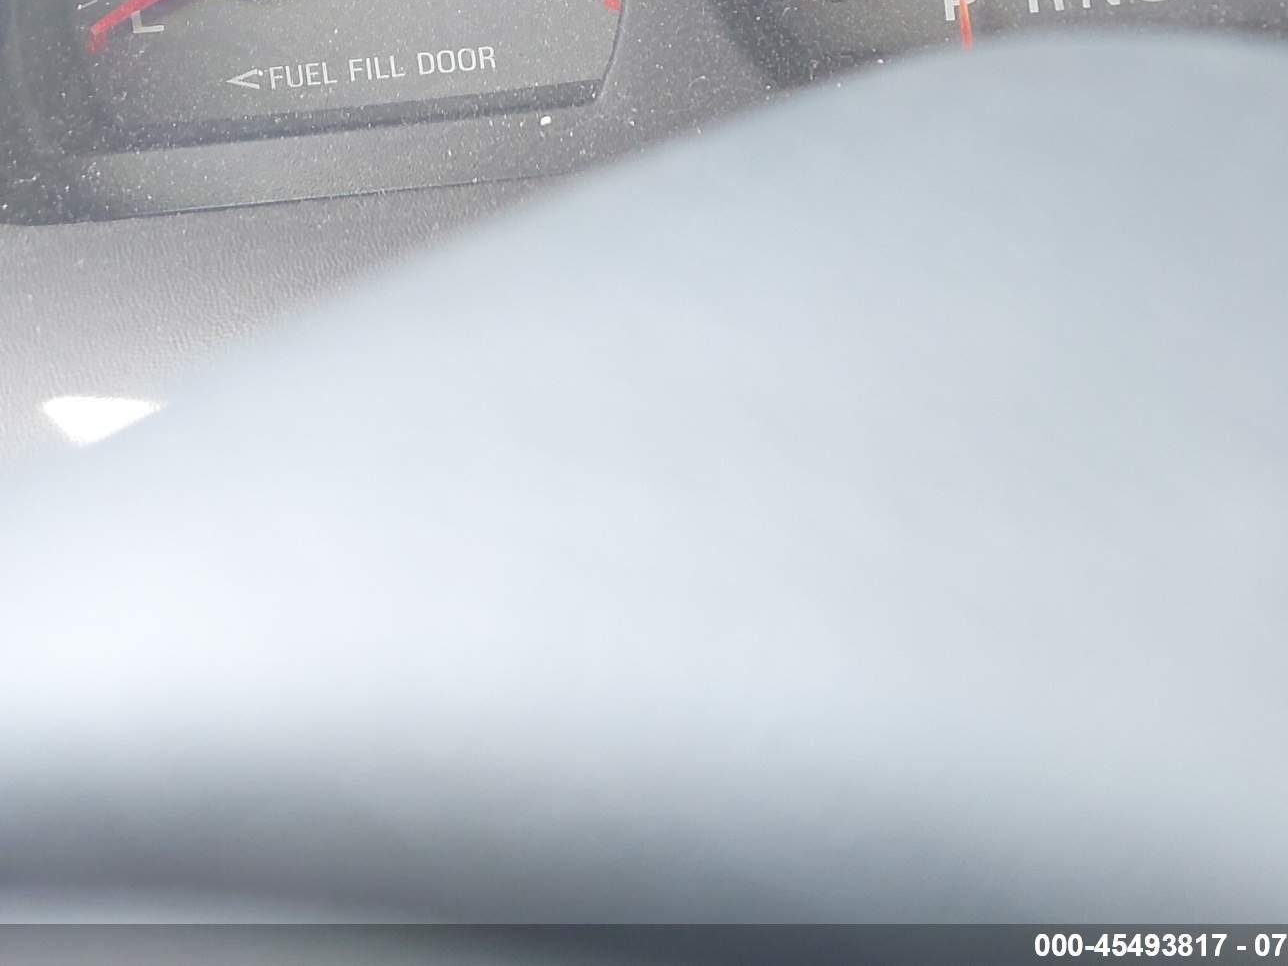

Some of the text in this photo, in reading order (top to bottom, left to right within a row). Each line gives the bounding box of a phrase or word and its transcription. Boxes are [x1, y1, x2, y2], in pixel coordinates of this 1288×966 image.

[269, 46, 496, 89] FUEL FILL DOOR
